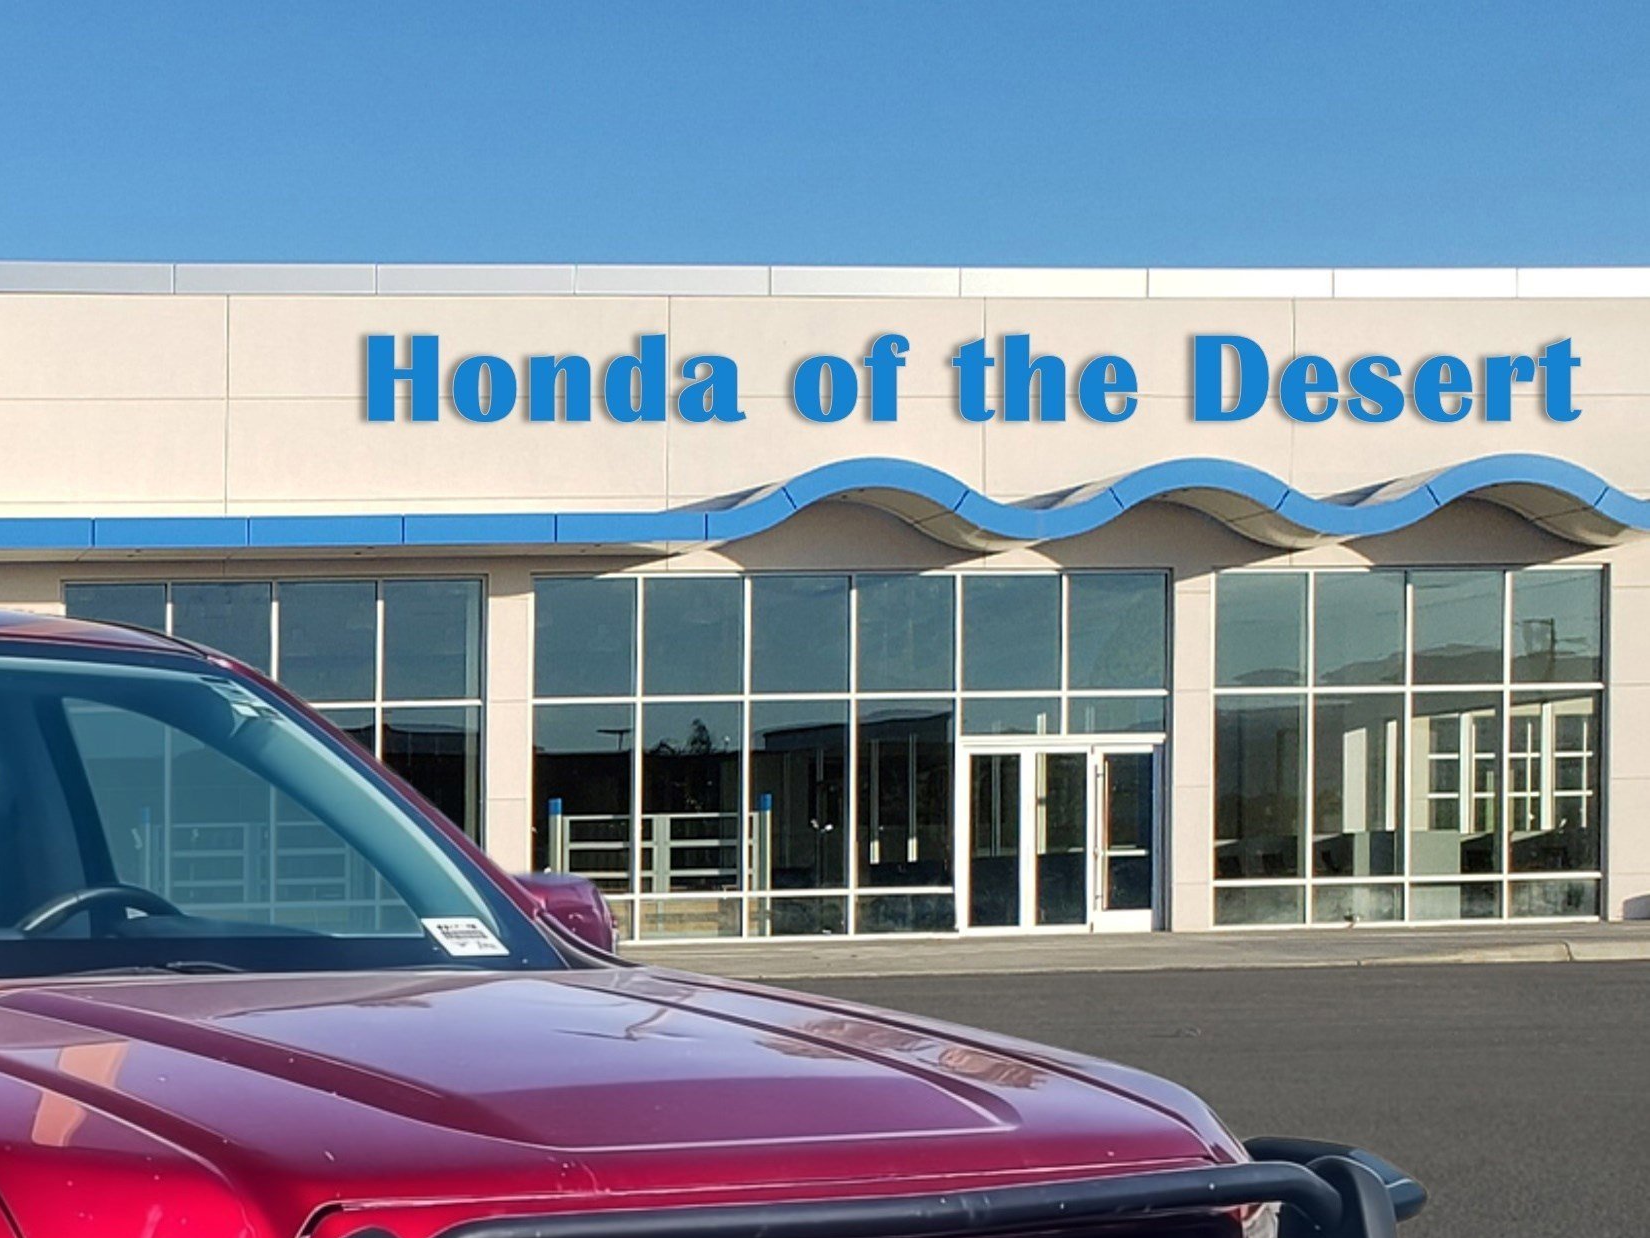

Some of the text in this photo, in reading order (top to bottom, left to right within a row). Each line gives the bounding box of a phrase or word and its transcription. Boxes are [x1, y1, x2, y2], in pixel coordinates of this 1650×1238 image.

[365, 332, 1583, 425] Honda of the Desert
